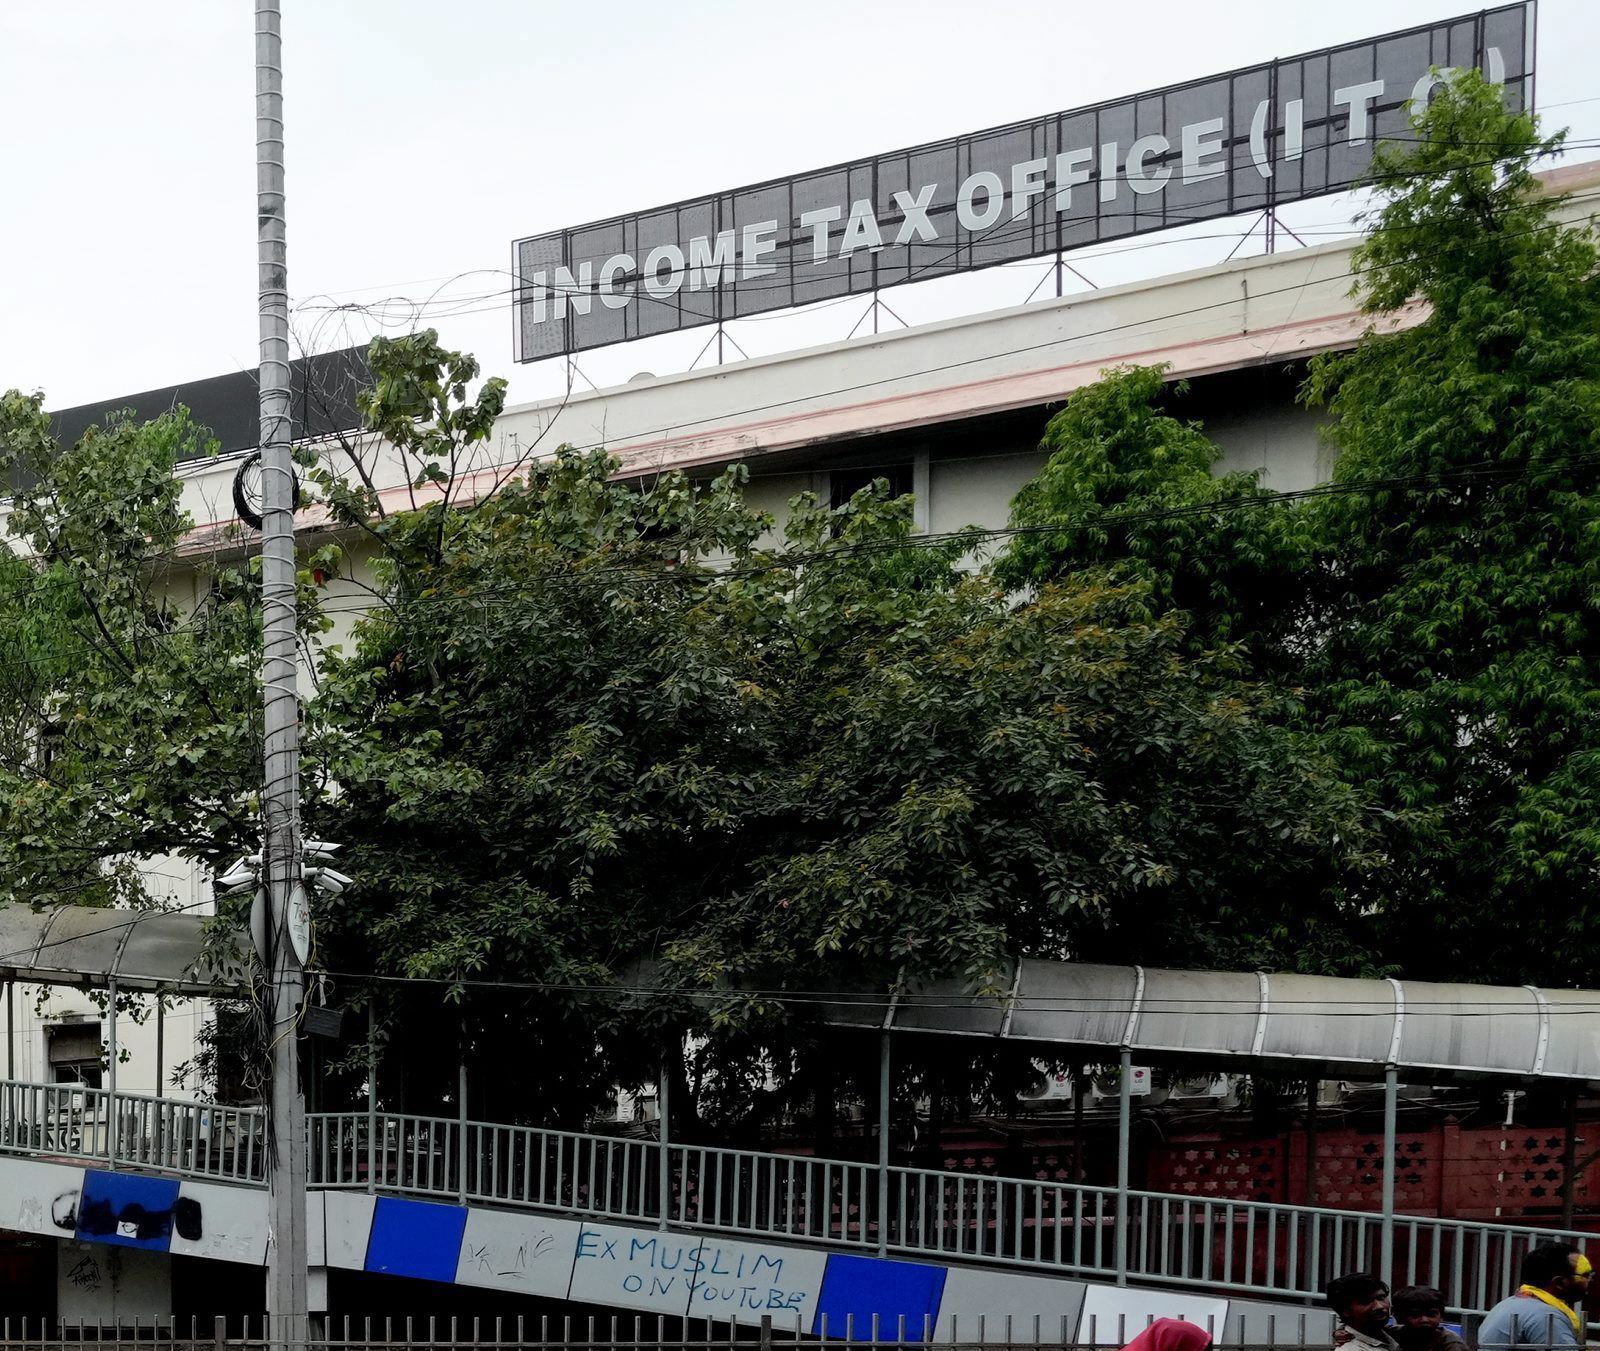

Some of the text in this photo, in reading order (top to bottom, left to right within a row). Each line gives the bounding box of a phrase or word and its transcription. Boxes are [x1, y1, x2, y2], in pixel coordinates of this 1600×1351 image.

[531, 218, 778, 325] INCOME
[800, 182, 939, 265] TAX
[957, 117, 1228, 232] OFFICE
[629, 1238, 784, 1284] MUSLIM
[623, 1275, 806, 1312] ON YOUTUBE
